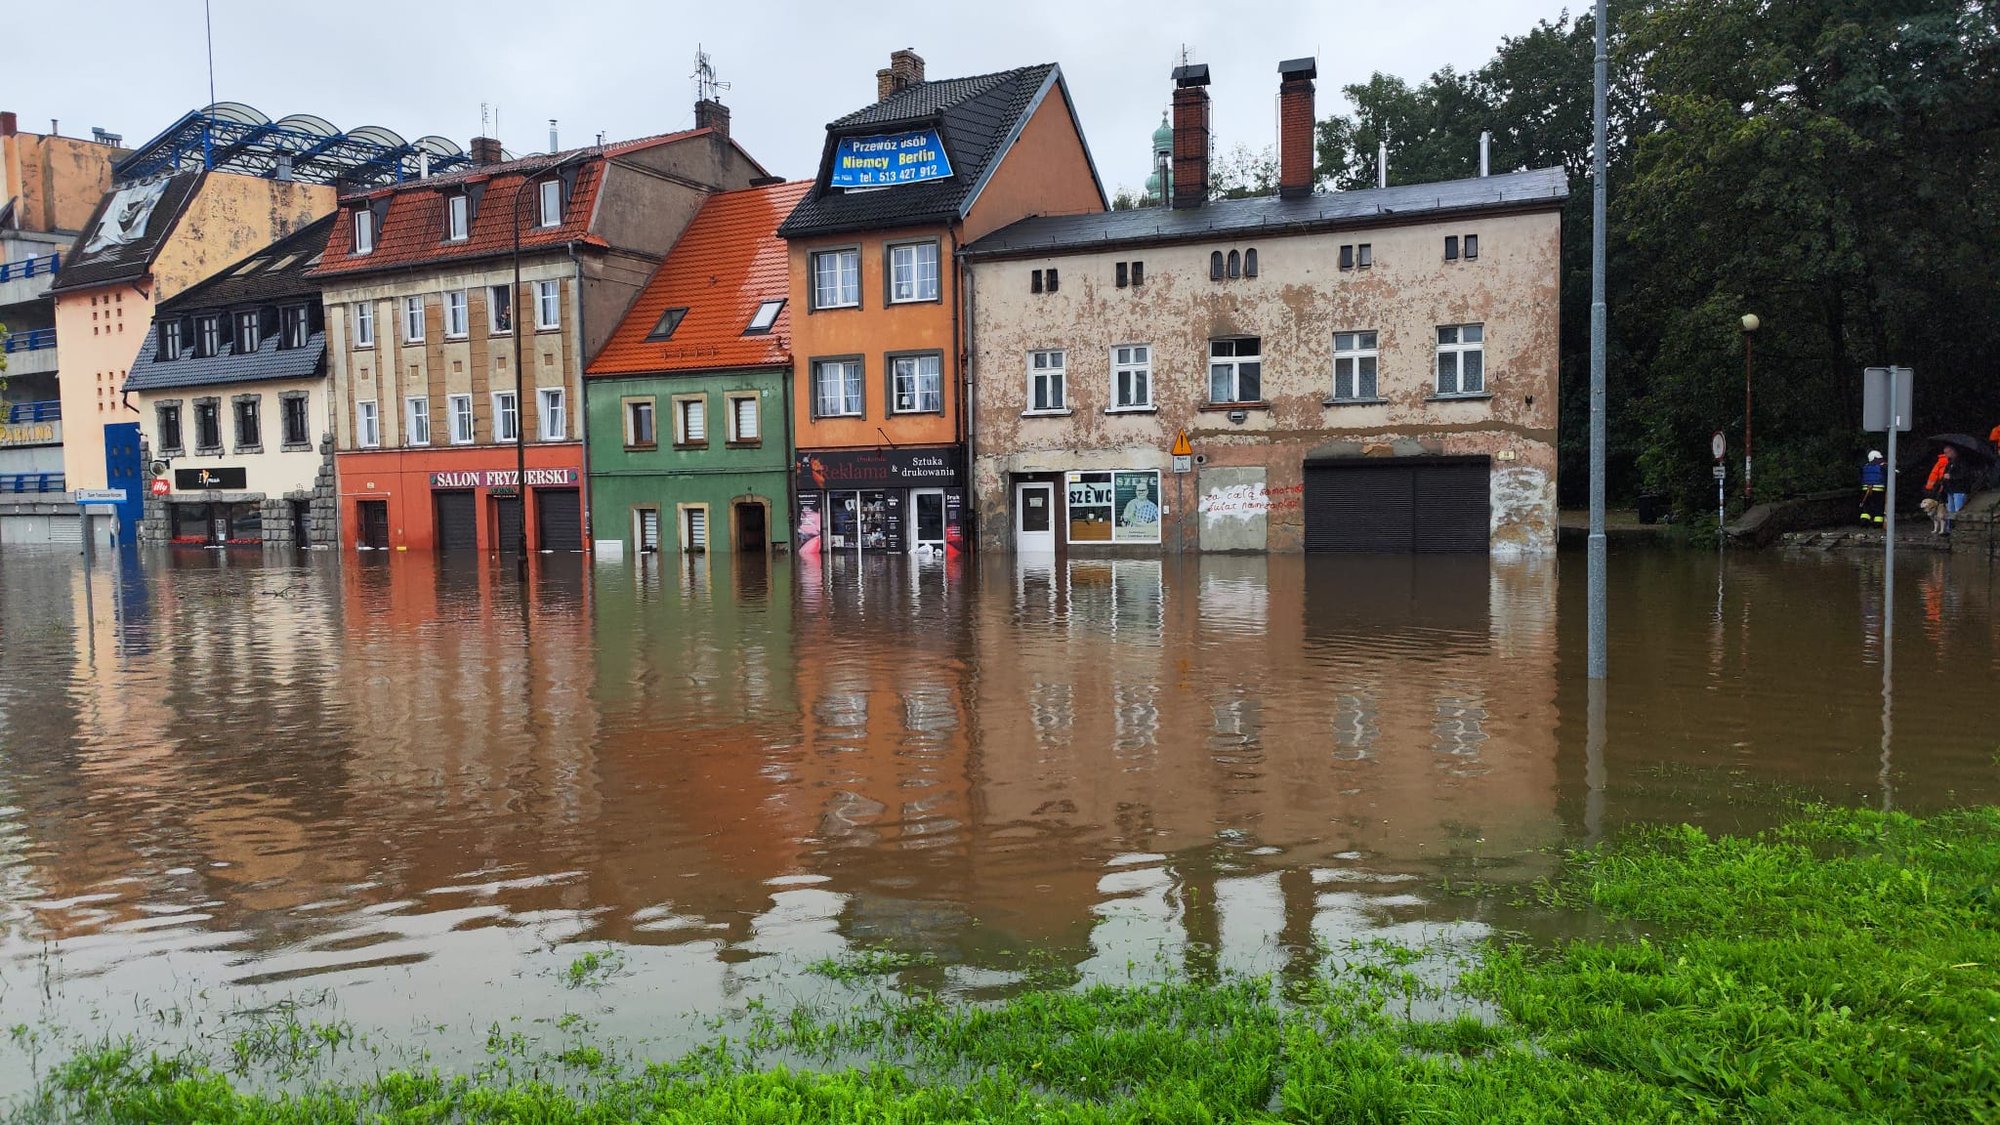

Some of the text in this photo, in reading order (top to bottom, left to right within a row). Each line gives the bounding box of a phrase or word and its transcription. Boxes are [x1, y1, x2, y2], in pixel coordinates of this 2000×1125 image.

[853, 141, 897, 152] Przewóz
[842, 149, 936, 169] Niemcy Berlin
[860, 172, 875, 183] tel.
[879, 171, 896, 181] 513
[900, 168, 916, 180] 427
[920, 165, 937, 177] 912
[912, 456, 943, 467] Sztuka
[820, 462, 888, 481] Reklama
[901, 467, 955, 477] drukowania
[153, 481, 168, 493] illy
[437, 472, 480, 487] SALON
[1069, 489, 1112, 504] SZEWC
